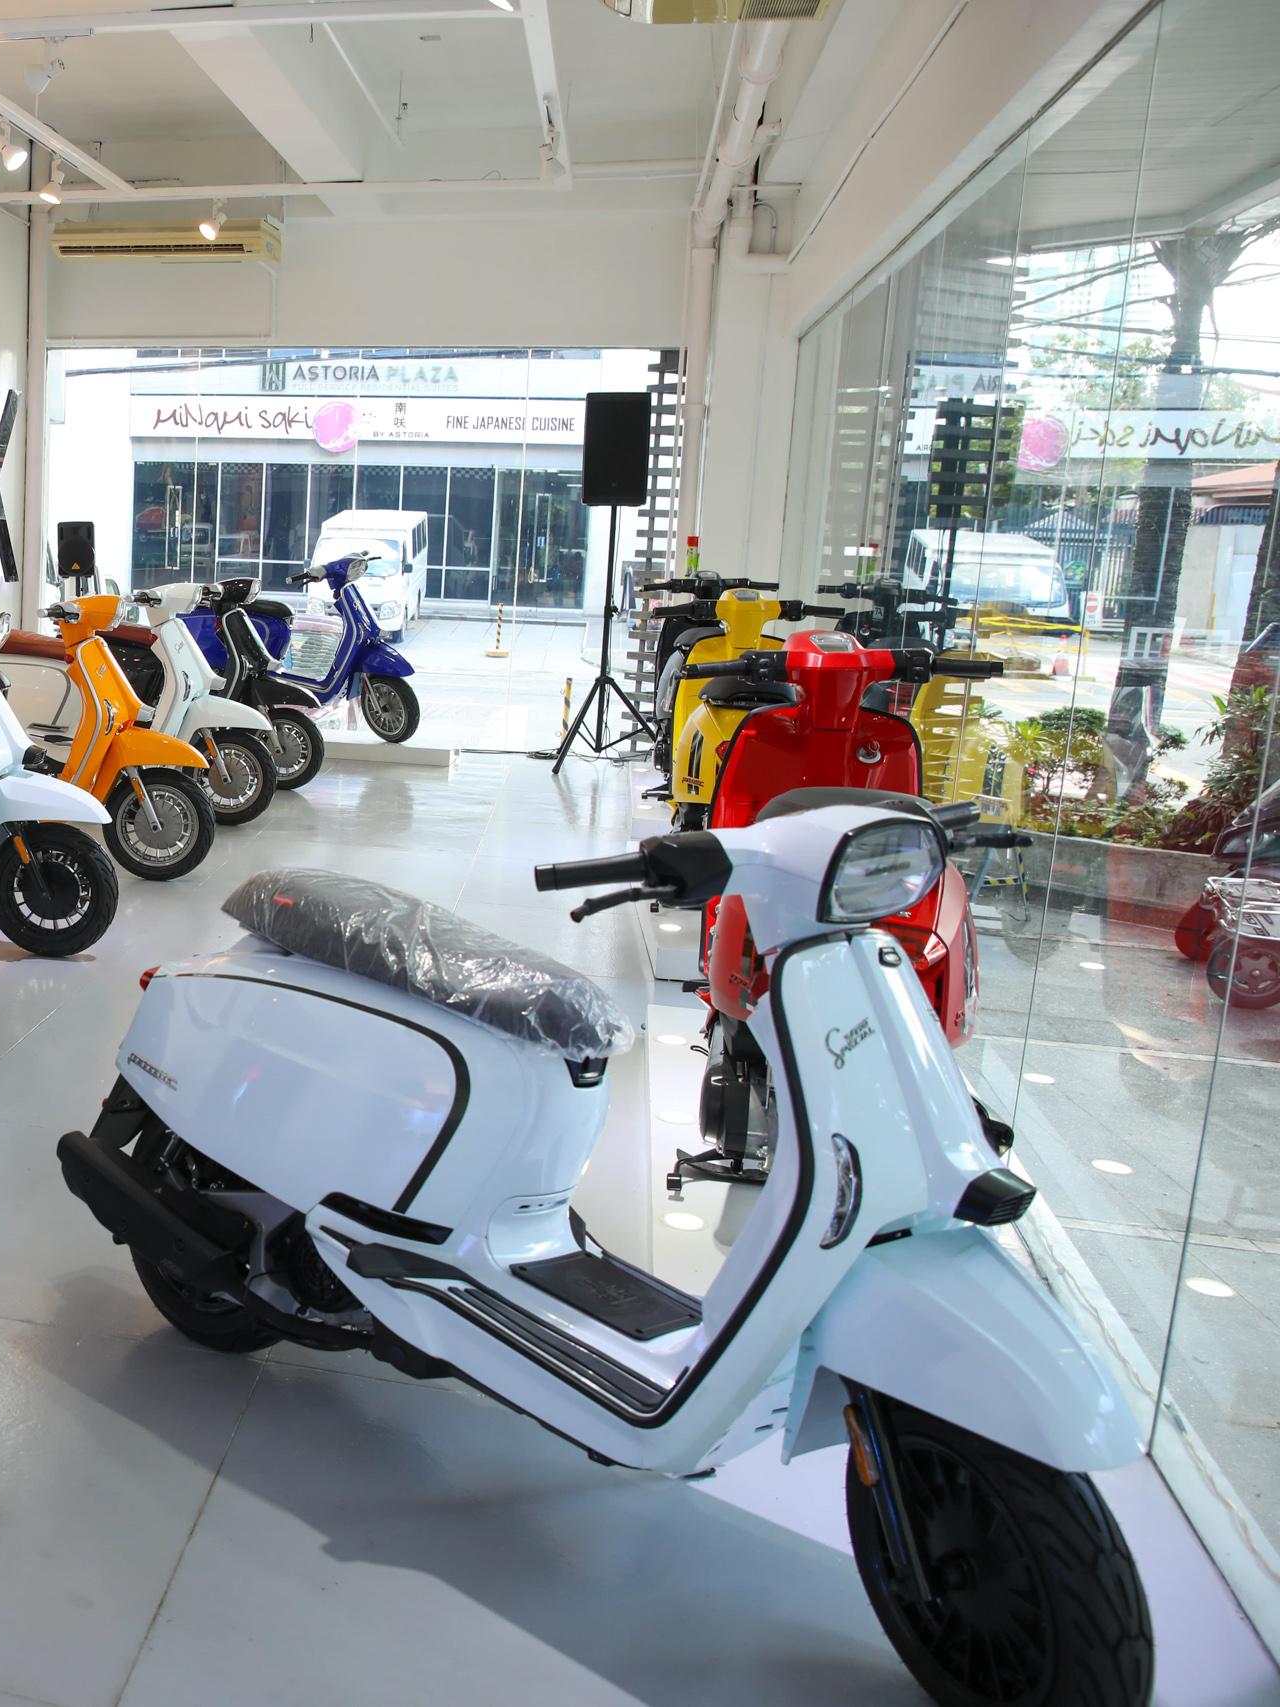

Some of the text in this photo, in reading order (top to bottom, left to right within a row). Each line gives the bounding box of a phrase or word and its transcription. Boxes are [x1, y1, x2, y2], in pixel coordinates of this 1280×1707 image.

[292, 364, 459, 383] ASTORIA PLAZA
[445, 415, 469, 430] FINE
[531, 416, 575, 432] CUISINE
[388, 431, 430, 439] ASTORIA
